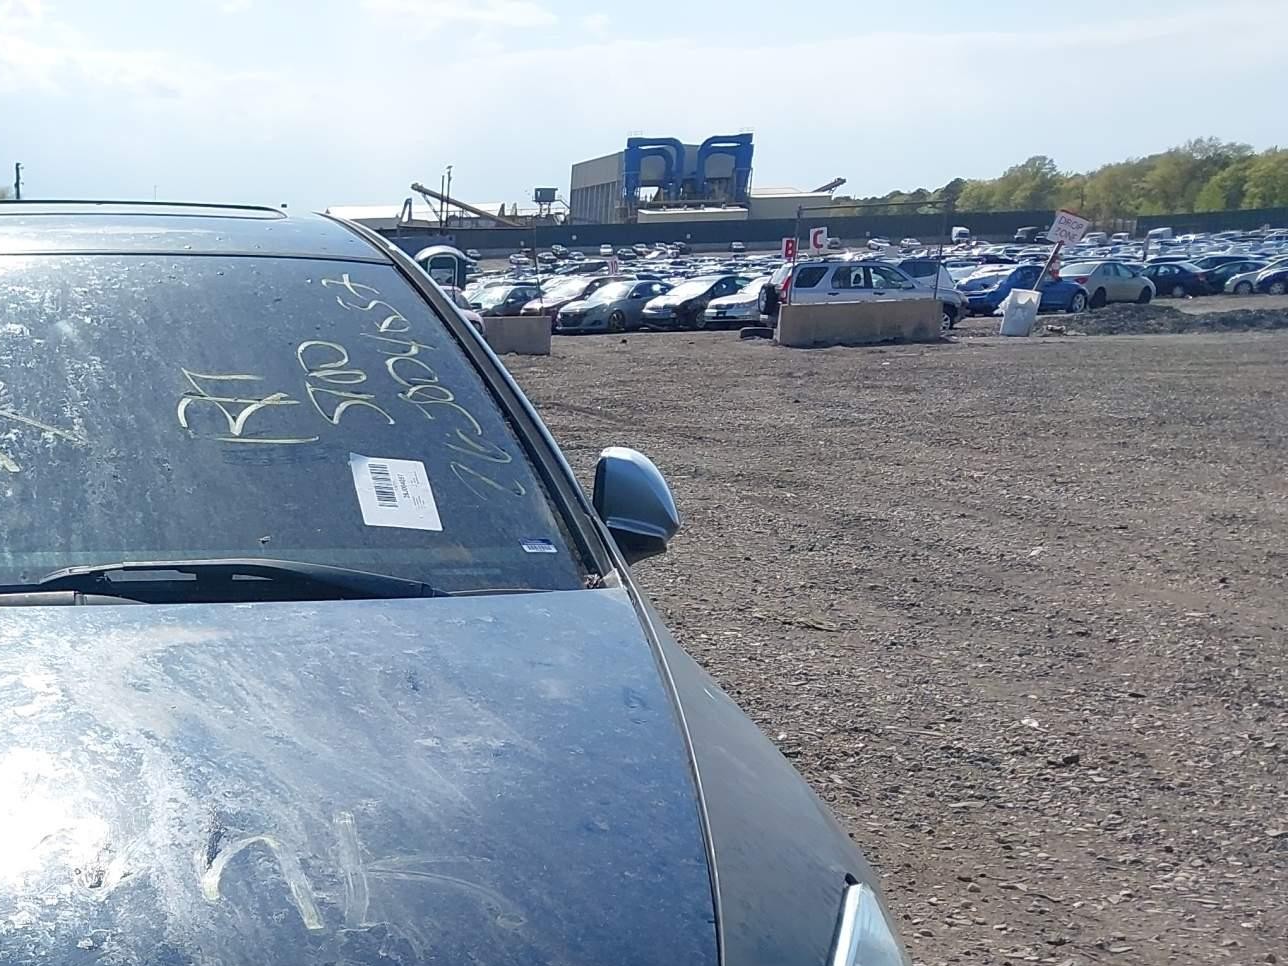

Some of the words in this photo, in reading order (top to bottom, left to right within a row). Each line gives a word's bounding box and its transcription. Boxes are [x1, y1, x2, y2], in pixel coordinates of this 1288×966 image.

[1059, 215, 1083, 230] DROP
[785, 239, 796, 257] B
[813, 230, 824, 249] C
